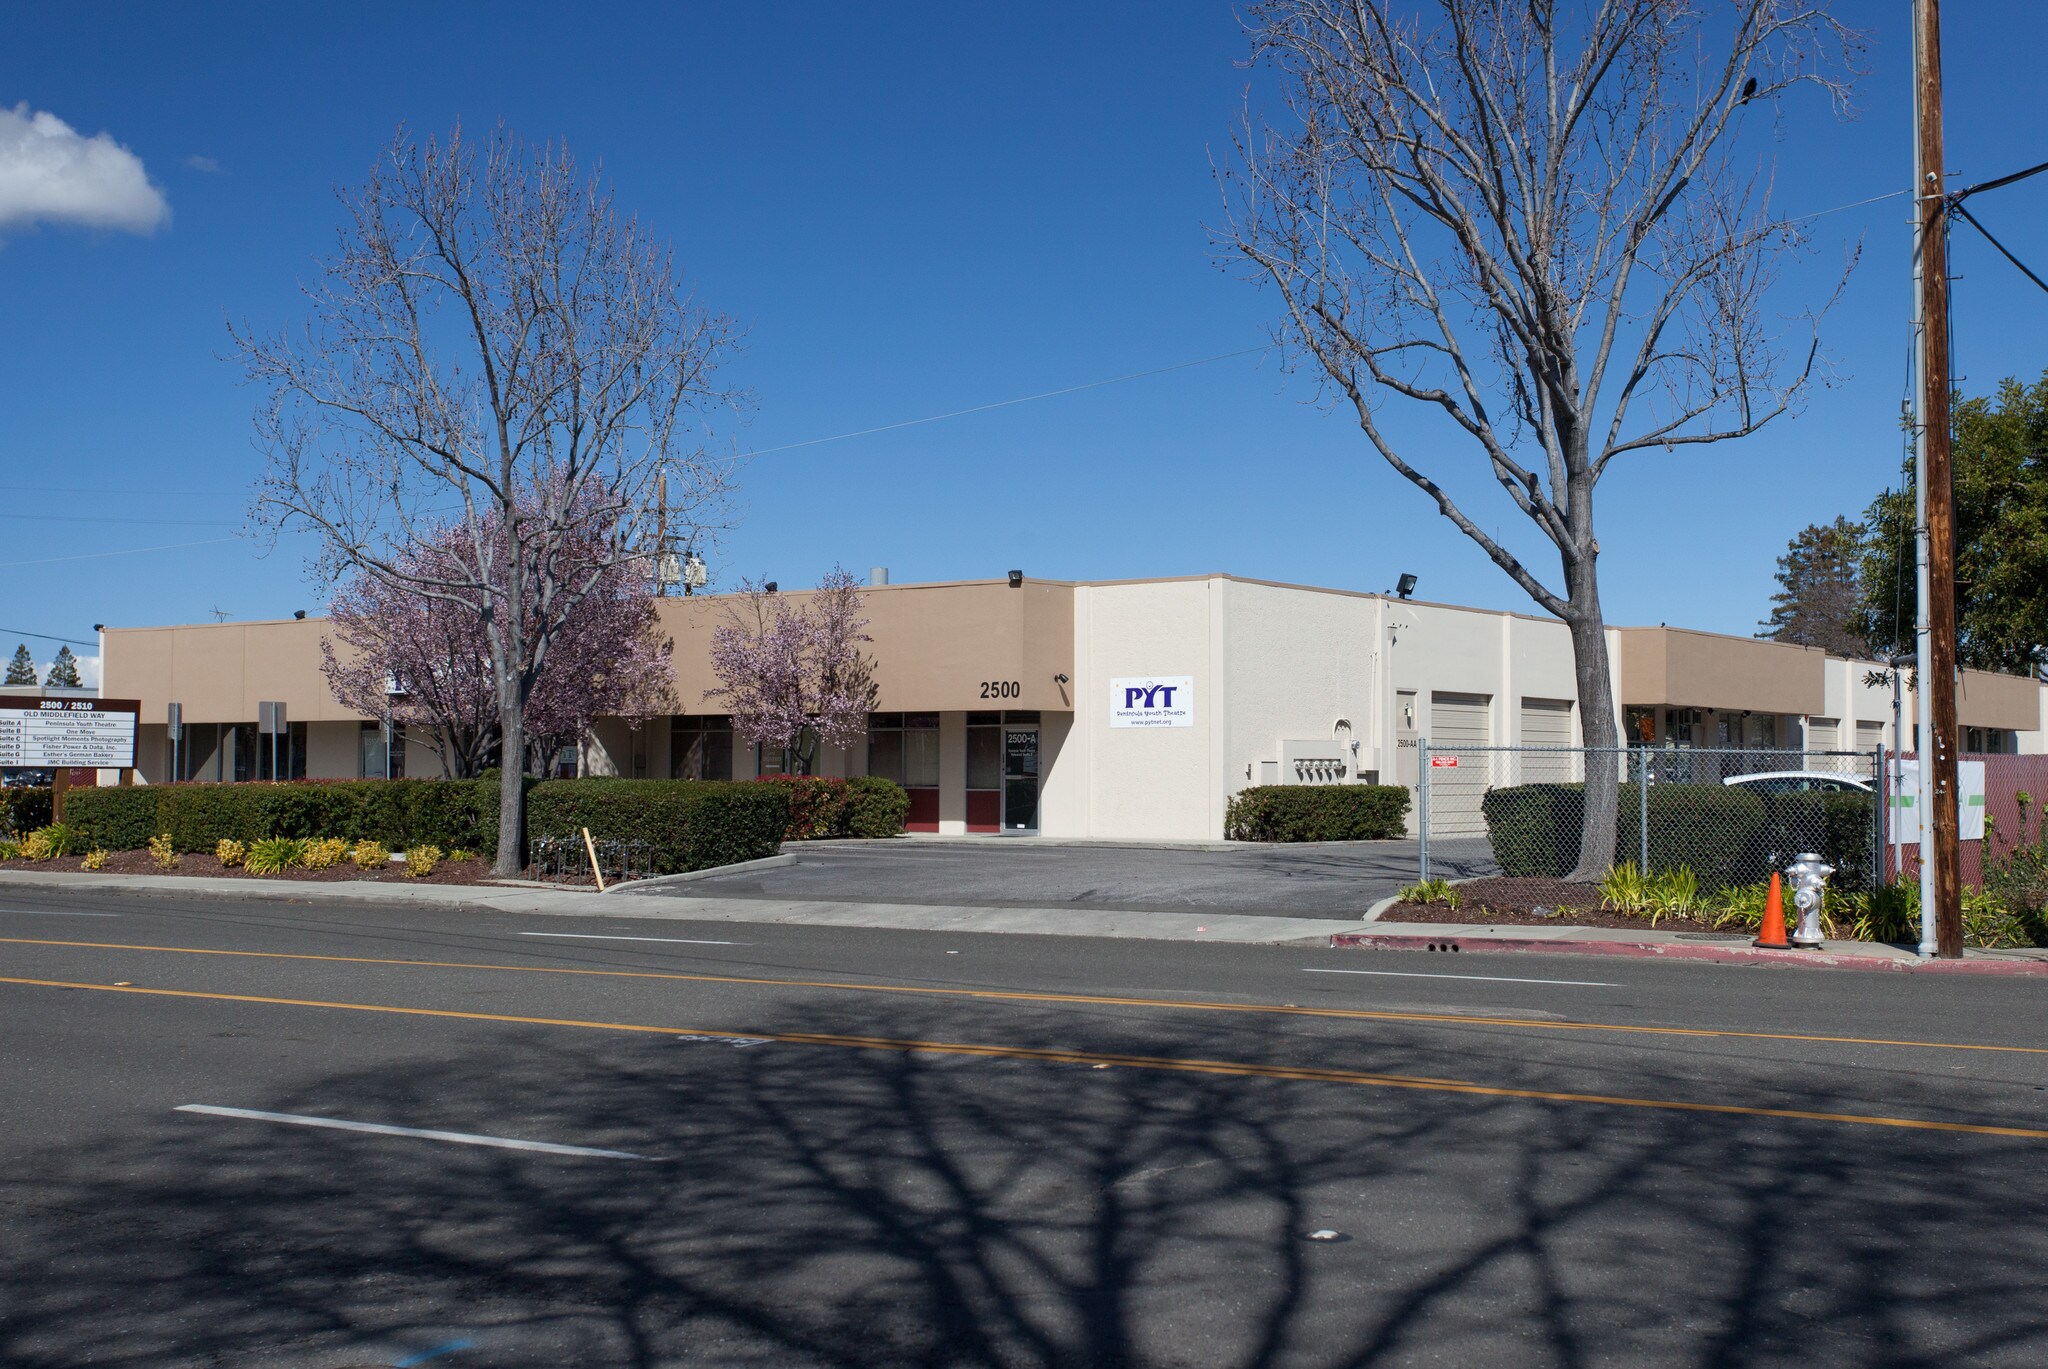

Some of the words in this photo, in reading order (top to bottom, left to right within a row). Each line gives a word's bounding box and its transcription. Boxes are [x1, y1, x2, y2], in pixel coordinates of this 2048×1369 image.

[980, 681, 1020, 698] 2500
[1125, 684, 1178, 708] PYT
[40, 701, 62, 709] 2500
[64, 702, 69, 710] /
[71, 702, 93, 710] 2510
[1008, 734, 1036, 743] 2500-A
[1398, 739, 1417, 748] 2500-AA
